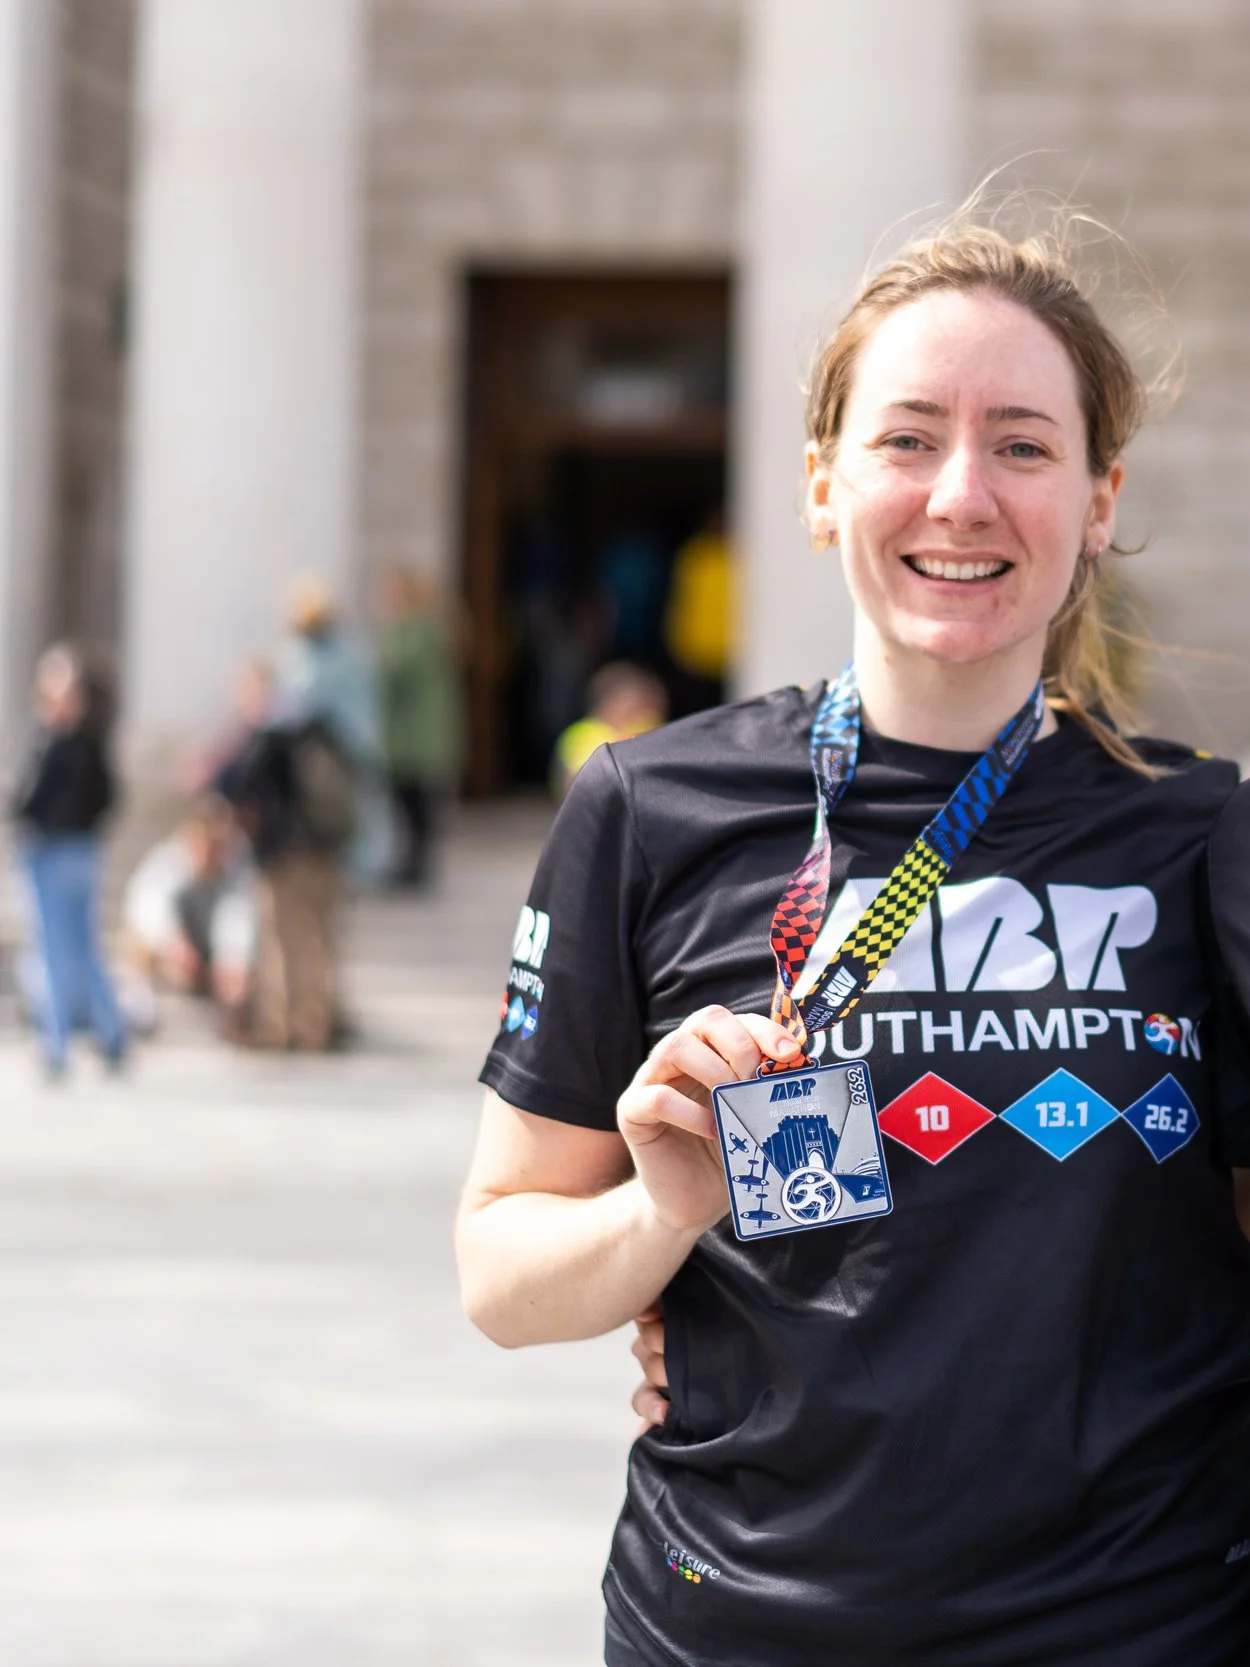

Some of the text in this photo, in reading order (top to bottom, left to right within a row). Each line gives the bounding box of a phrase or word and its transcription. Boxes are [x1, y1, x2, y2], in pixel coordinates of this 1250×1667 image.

[513, 904, 551, 970] BP
[790, 876, 1158, 999] ABP
[821, 965, 858, 1007] ABP
[808, 1008, 1202, 1062] UTHAMPTON
[769, 1078, 816, 1103] ABP
[847, 1067, 869, 1105] 26.2
[915, 1106, 949, 1132] 10
[1036, 1101, 1088, 1128] 13.1
[1144, 1104, 1188, 1133] 26.2
